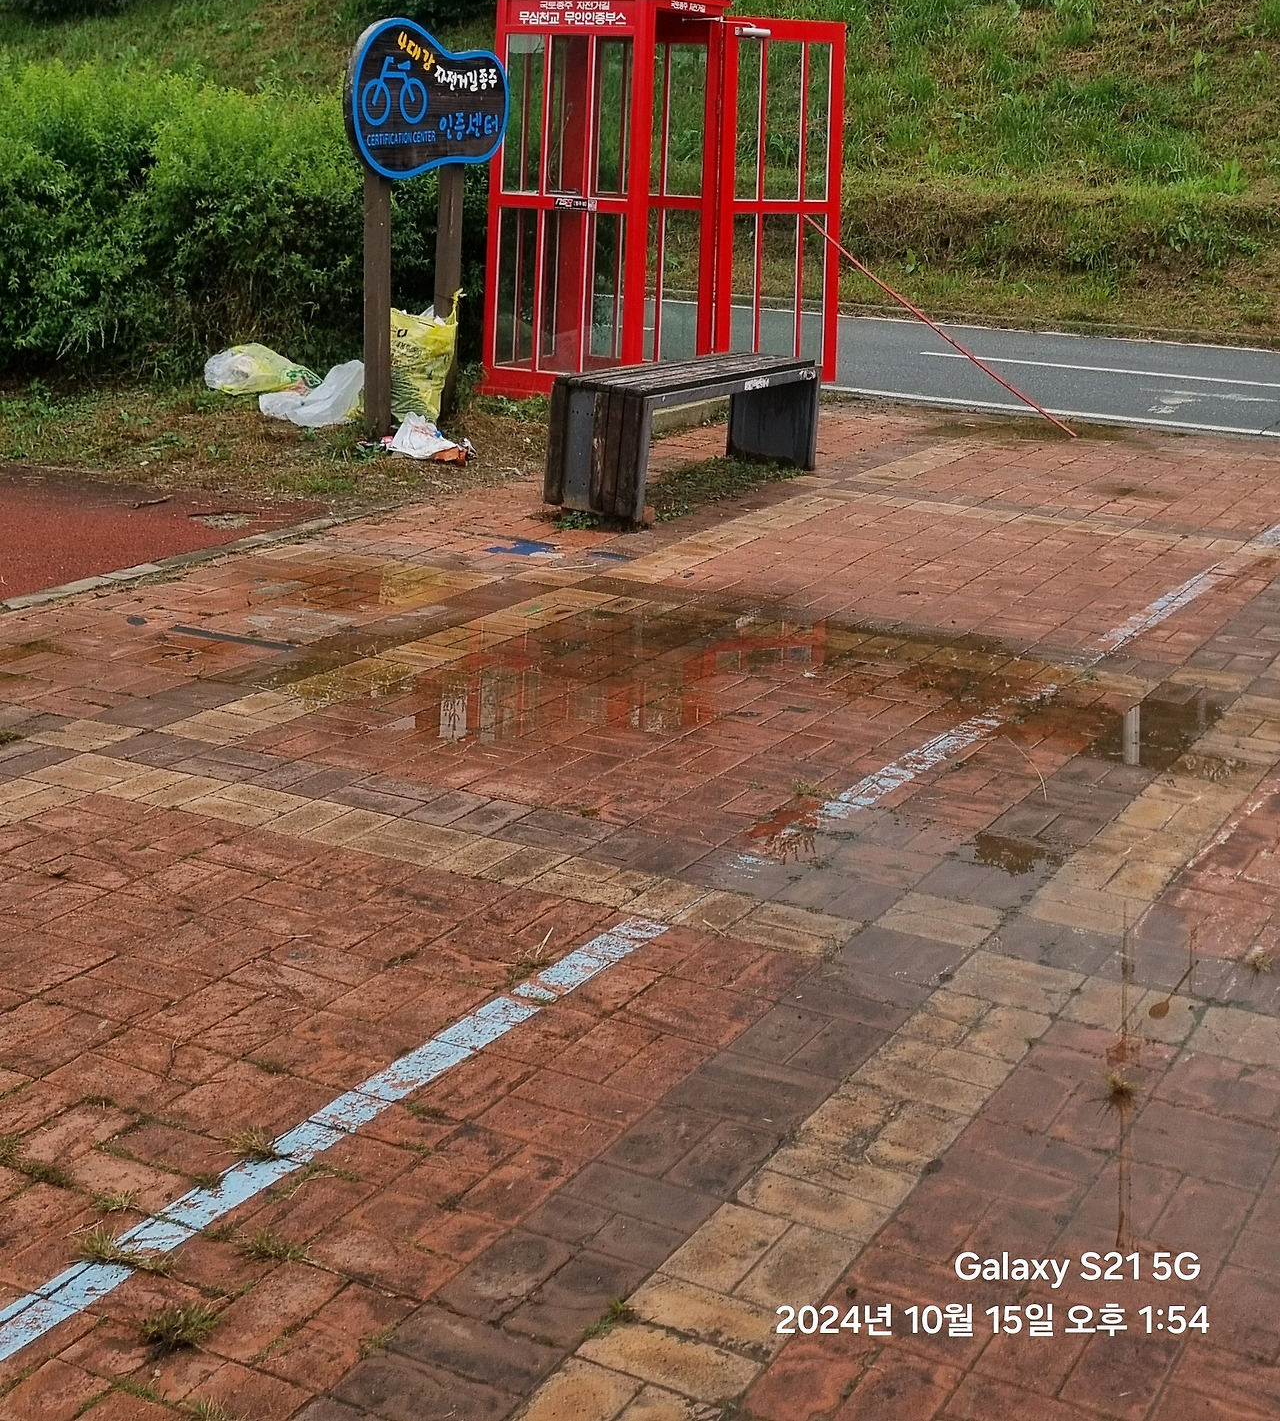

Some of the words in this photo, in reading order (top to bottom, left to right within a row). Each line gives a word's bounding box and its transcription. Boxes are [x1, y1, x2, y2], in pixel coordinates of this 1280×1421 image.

[540, 1, 573, 10] 국토종주
[576, 1, 610, 10] 자전거길
[519, 11, 560, 25] 무심천교
[564, 11, 627, 25] 무인인증부스
[397, 30, 436, 71] 4대강
[440, 112, 499, 140] 인증센터
[366, 131, 412, 147] CERTIFICATION
[412, 131, 436, 143] CENTER
